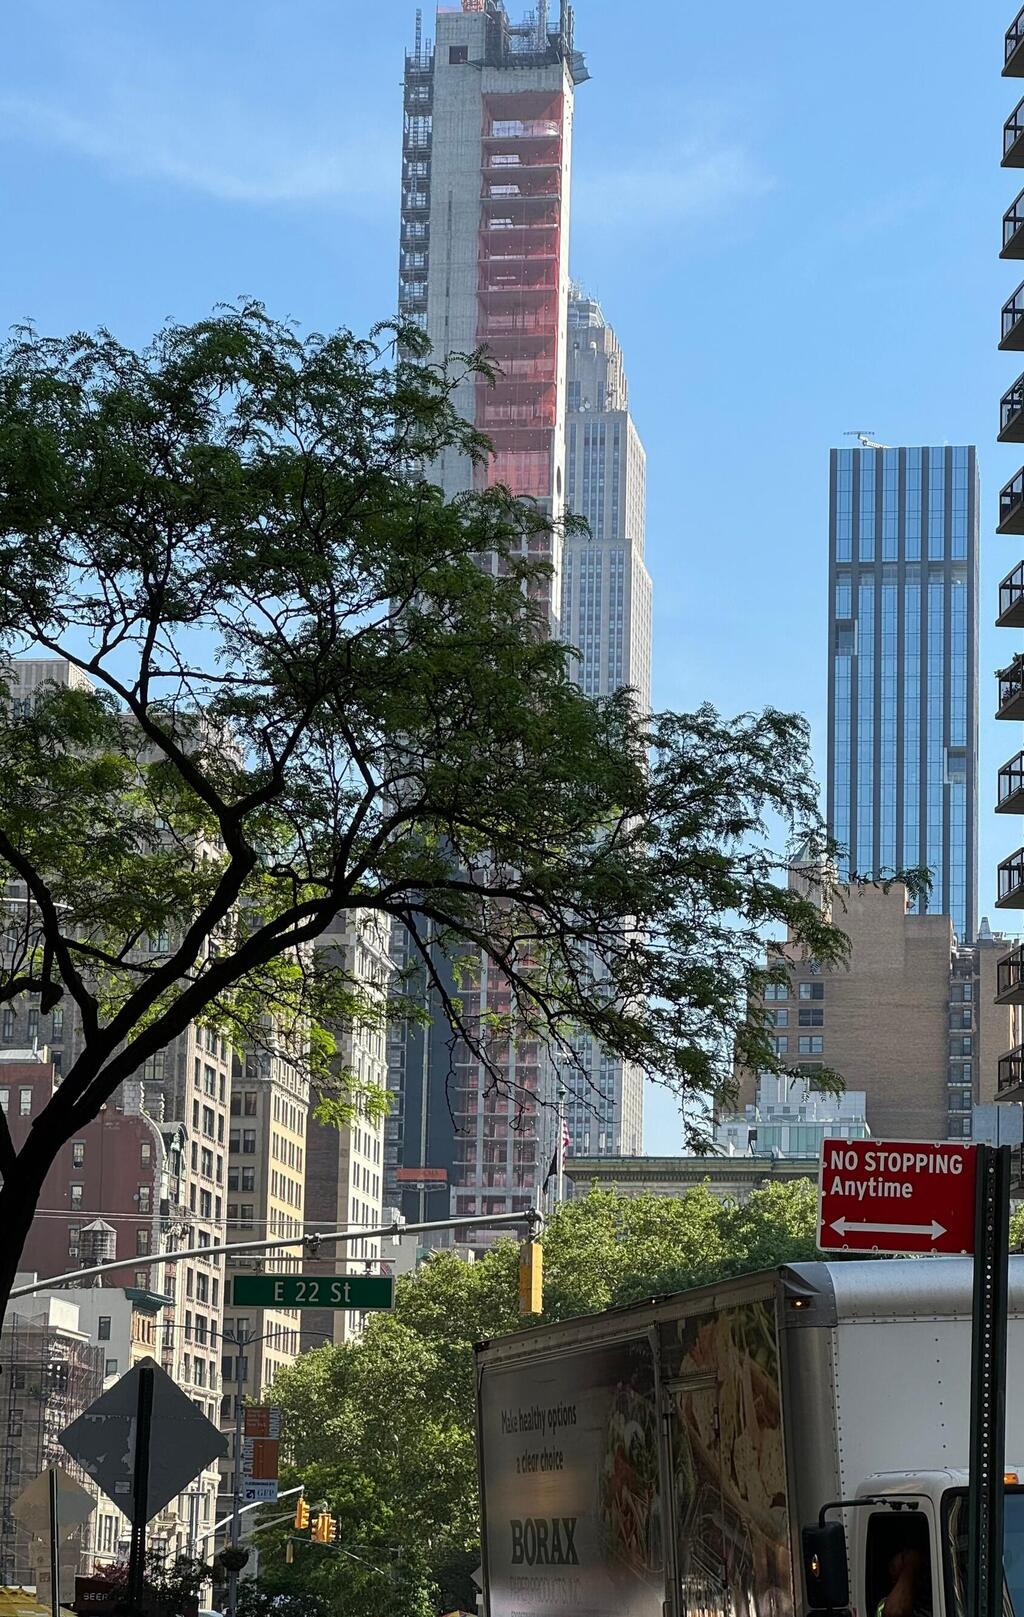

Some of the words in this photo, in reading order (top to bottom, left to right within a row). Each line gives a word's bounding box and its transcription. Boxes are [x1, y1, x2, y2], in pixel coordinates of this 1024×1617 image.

[830, 1150, 858, 1171] NO
[864, 1151, 963, 1175] STOPPING
[830, 1175, 913, 1201] Anytime
[274, 1281, 284, 1301] E
[295, 1281, 319, 1302] 22
[330, 1282, 351, 1303] St
[501, 1408, 518, 1434] Make
[519, 1404, 546, 1437] healthy
[547, 1400, 577, 1435] options
[522, 1448, 539, 1474] clear
[540, 1445, 564, 1472] choice
[510, 1517, 580, 1567] BORAX
[83, 1592, 109, 1601] BEER
